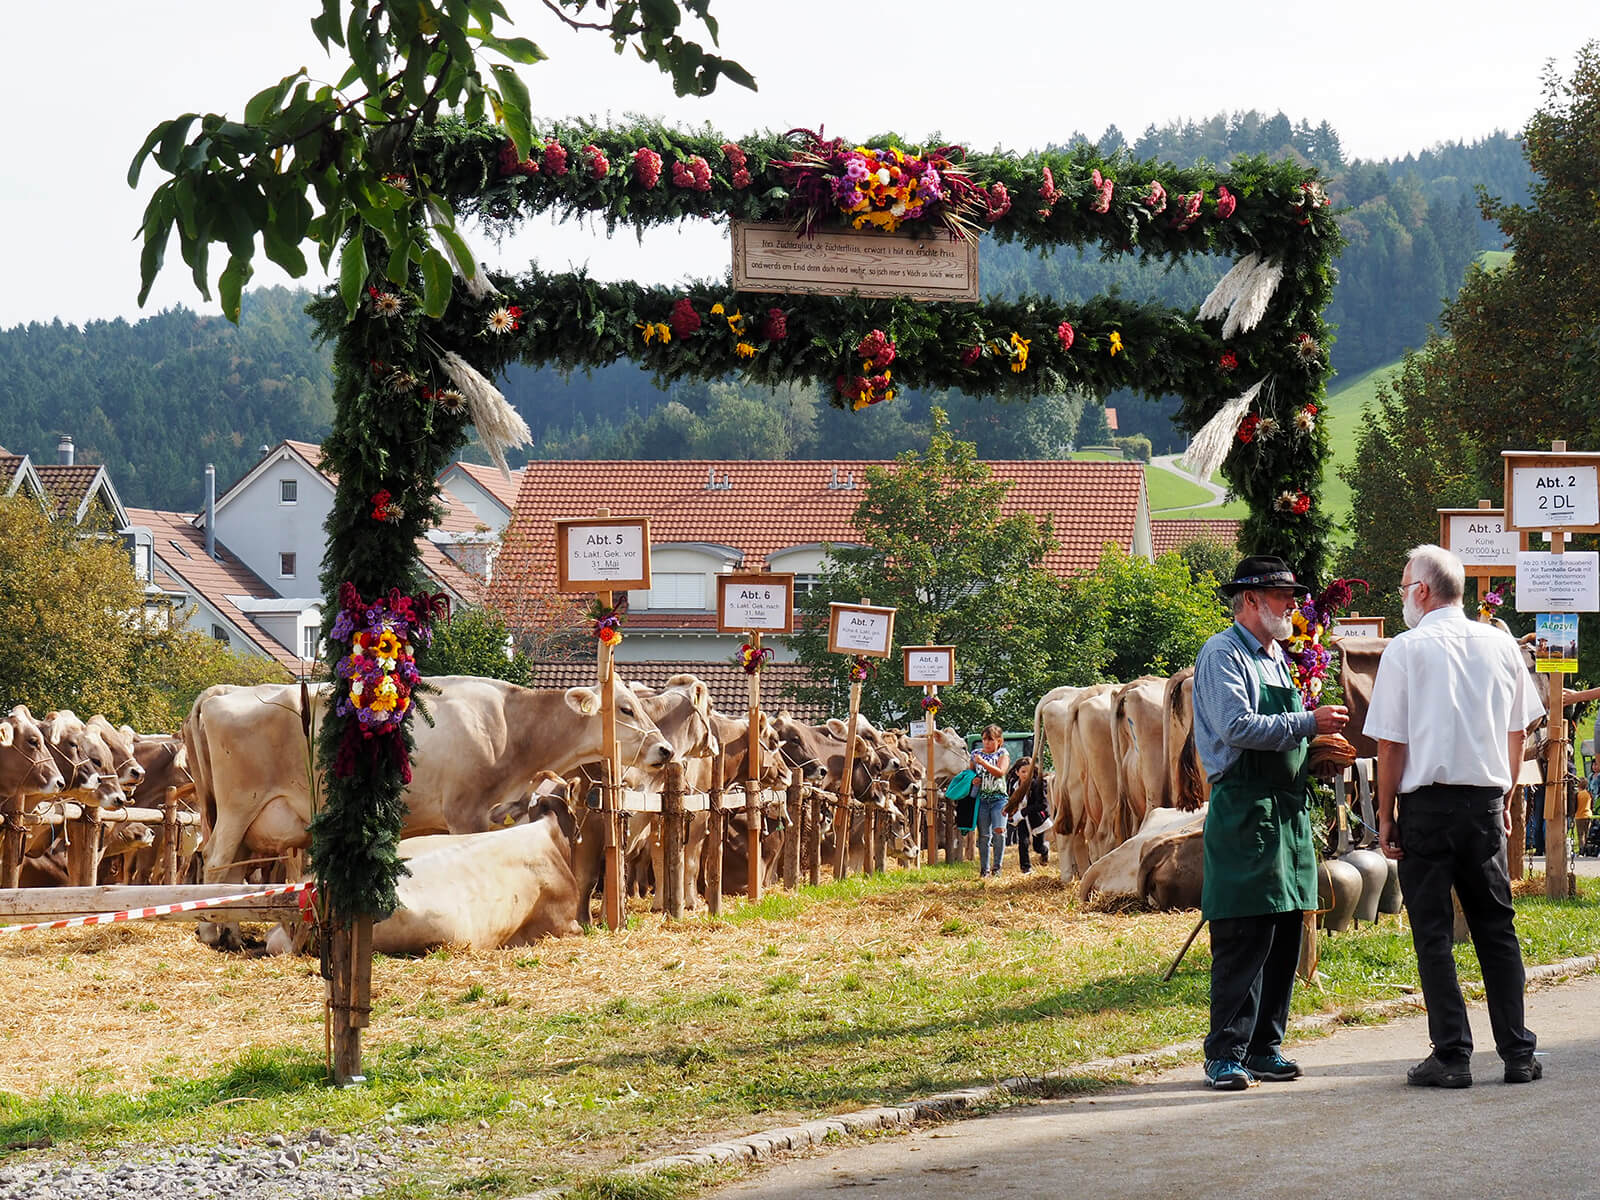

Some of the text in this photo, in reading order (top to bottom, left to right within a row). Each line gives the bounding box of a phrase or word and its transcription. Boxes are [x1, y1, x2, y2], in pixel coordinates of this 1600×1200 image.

[794, 262, 805, 271] End
[1536, 476, 1576, 488] Abt. 2
[1538, 495, 1575, 509] 2 DL
[1468, 524, 1502, 533] Abt. 3
[586, 534, 623, 545] Abt. 5
[583, 550, 602, 558] Lakt.
[604, 550, 621, 558] Gek.
[740, 590, 771, 600] Abt. 6
[850, 617, 867, 626] Abt.
